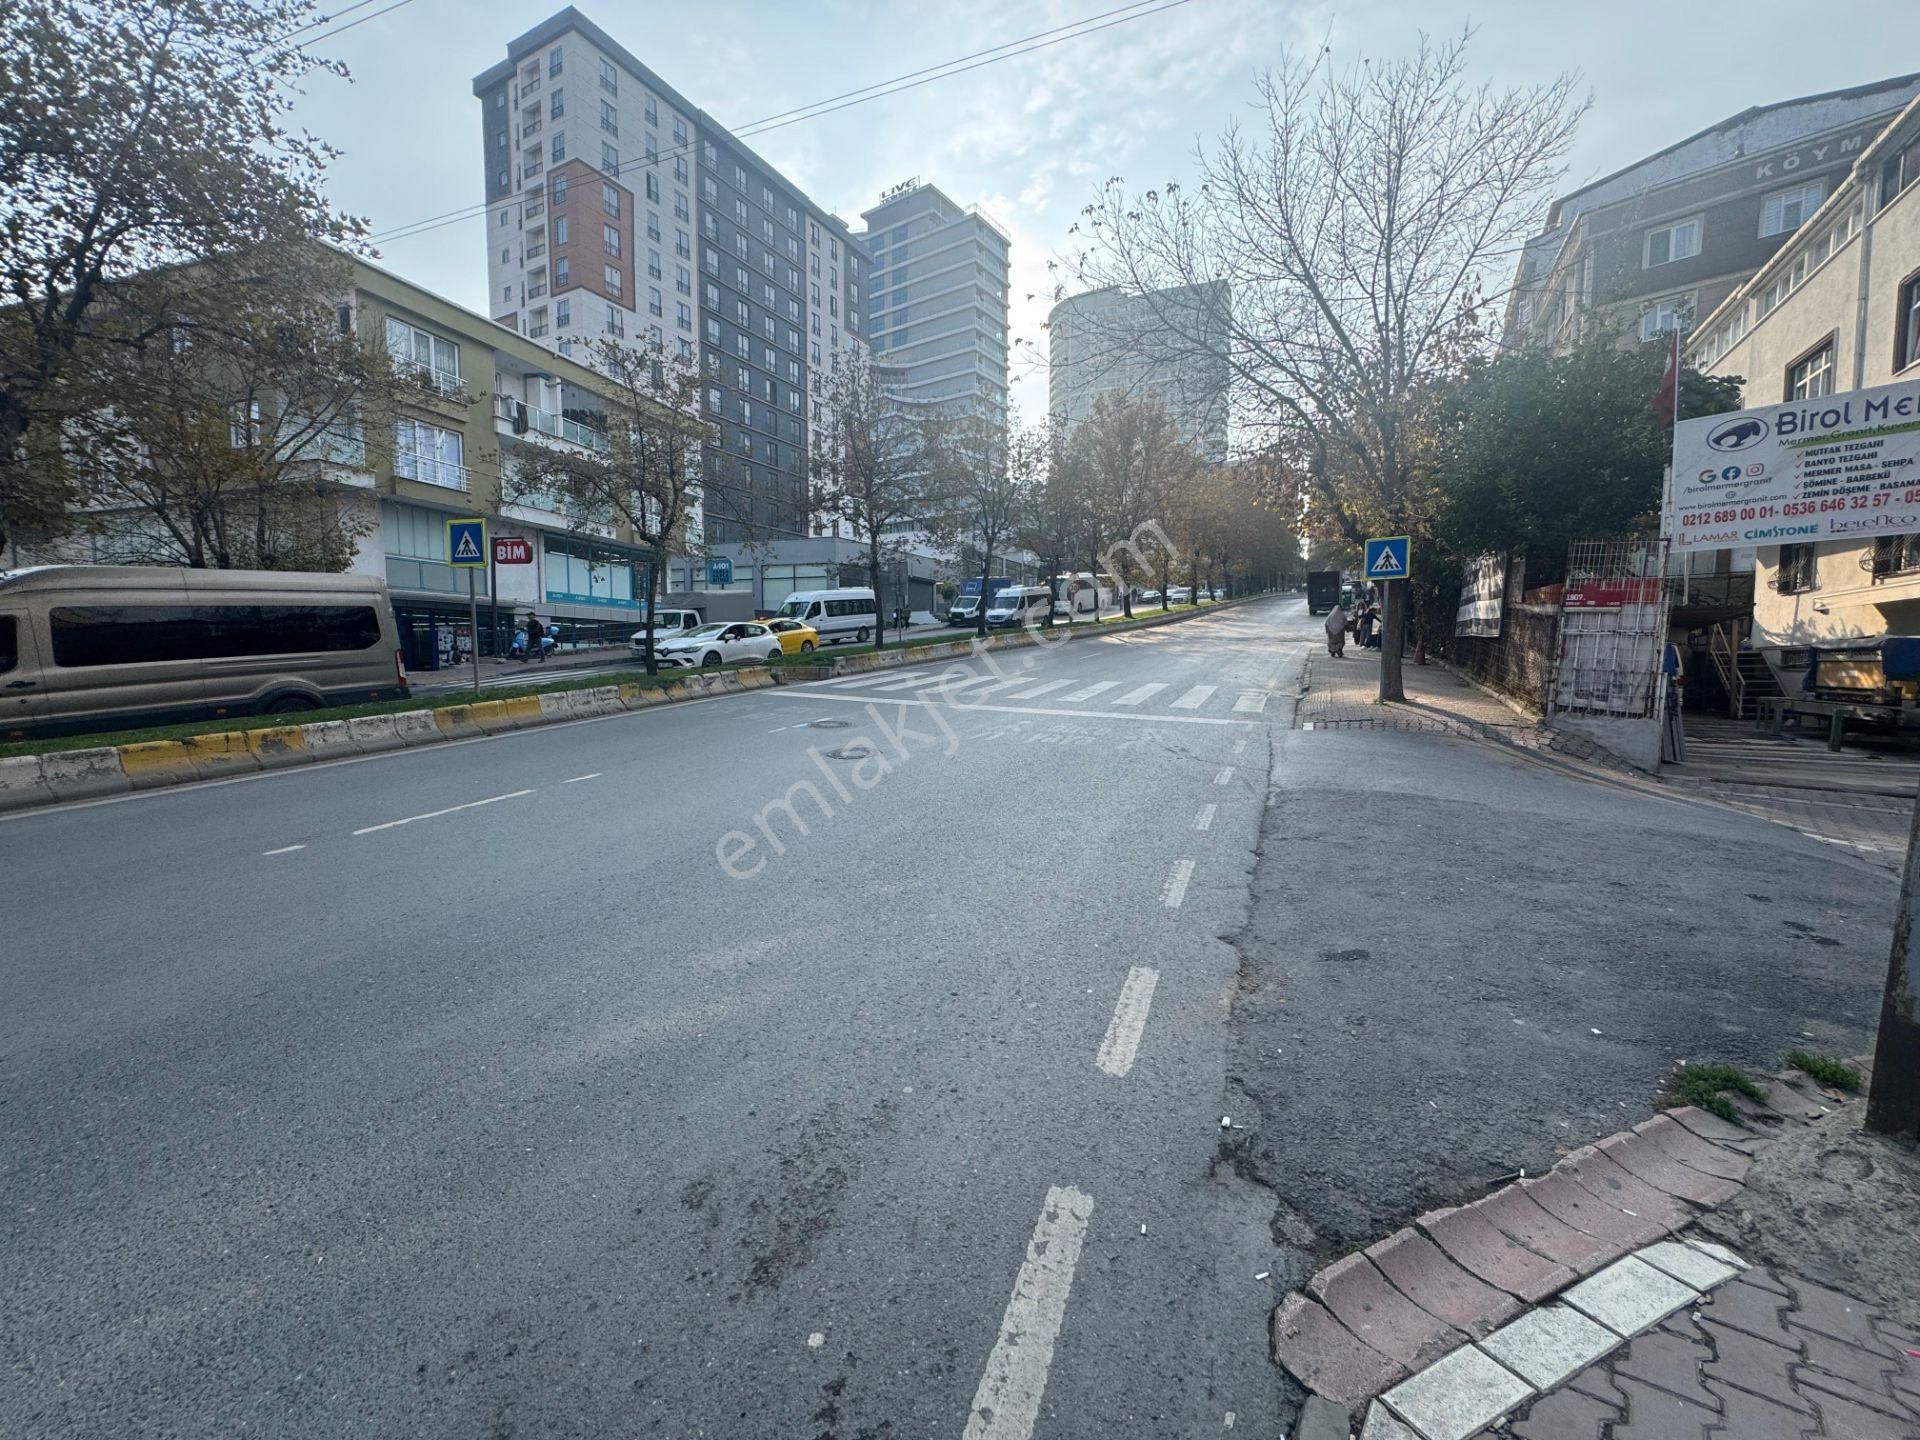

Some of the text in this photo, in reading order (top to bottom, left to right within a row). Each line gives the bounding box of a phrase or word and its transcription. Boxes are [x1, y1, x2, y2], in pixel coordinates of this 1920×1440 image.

[881, 176, 917, 198] LIVE
[1775, 394, 1920, 436] Birol ME
[1805, 439, 1884, 458] MUTFAK TEZGAHI
[1803, 467, 1842, 478] MERMER
[1844, 463, 1872, 473] MASA
[1881, 457, 1914, 469] SEHPA
[1804, 451, 1878, 468] BANYO TEZGAHI
[1683, 476, 1772, 495] /birolmermergranit
[1803, 477, 1838, 490] ŞÖMİNE
[1846, 469, 1891, 484] BARBEKÜ
[1802, 487, 1830, 499] ZEMİN
[1832, 484, 1871, 496] DÖŞEME
[1678, 493, 1787, 511] www.birolmermergranit.com
[1682, 512, 1711, 527] 0212
[1714, 509, 1737, 523] 689
[1740, 507, 1756, 521] 00
[1783, 501, 1816, 516] 0536
[1820, 497, 1846, 512] 646
[1850, 495, 1868, 510] 32
[1872, 492, 1891, 508] 57
[1693, 530, 1738, 542] LAMAR
[496, 541, 526, 560] BİM
